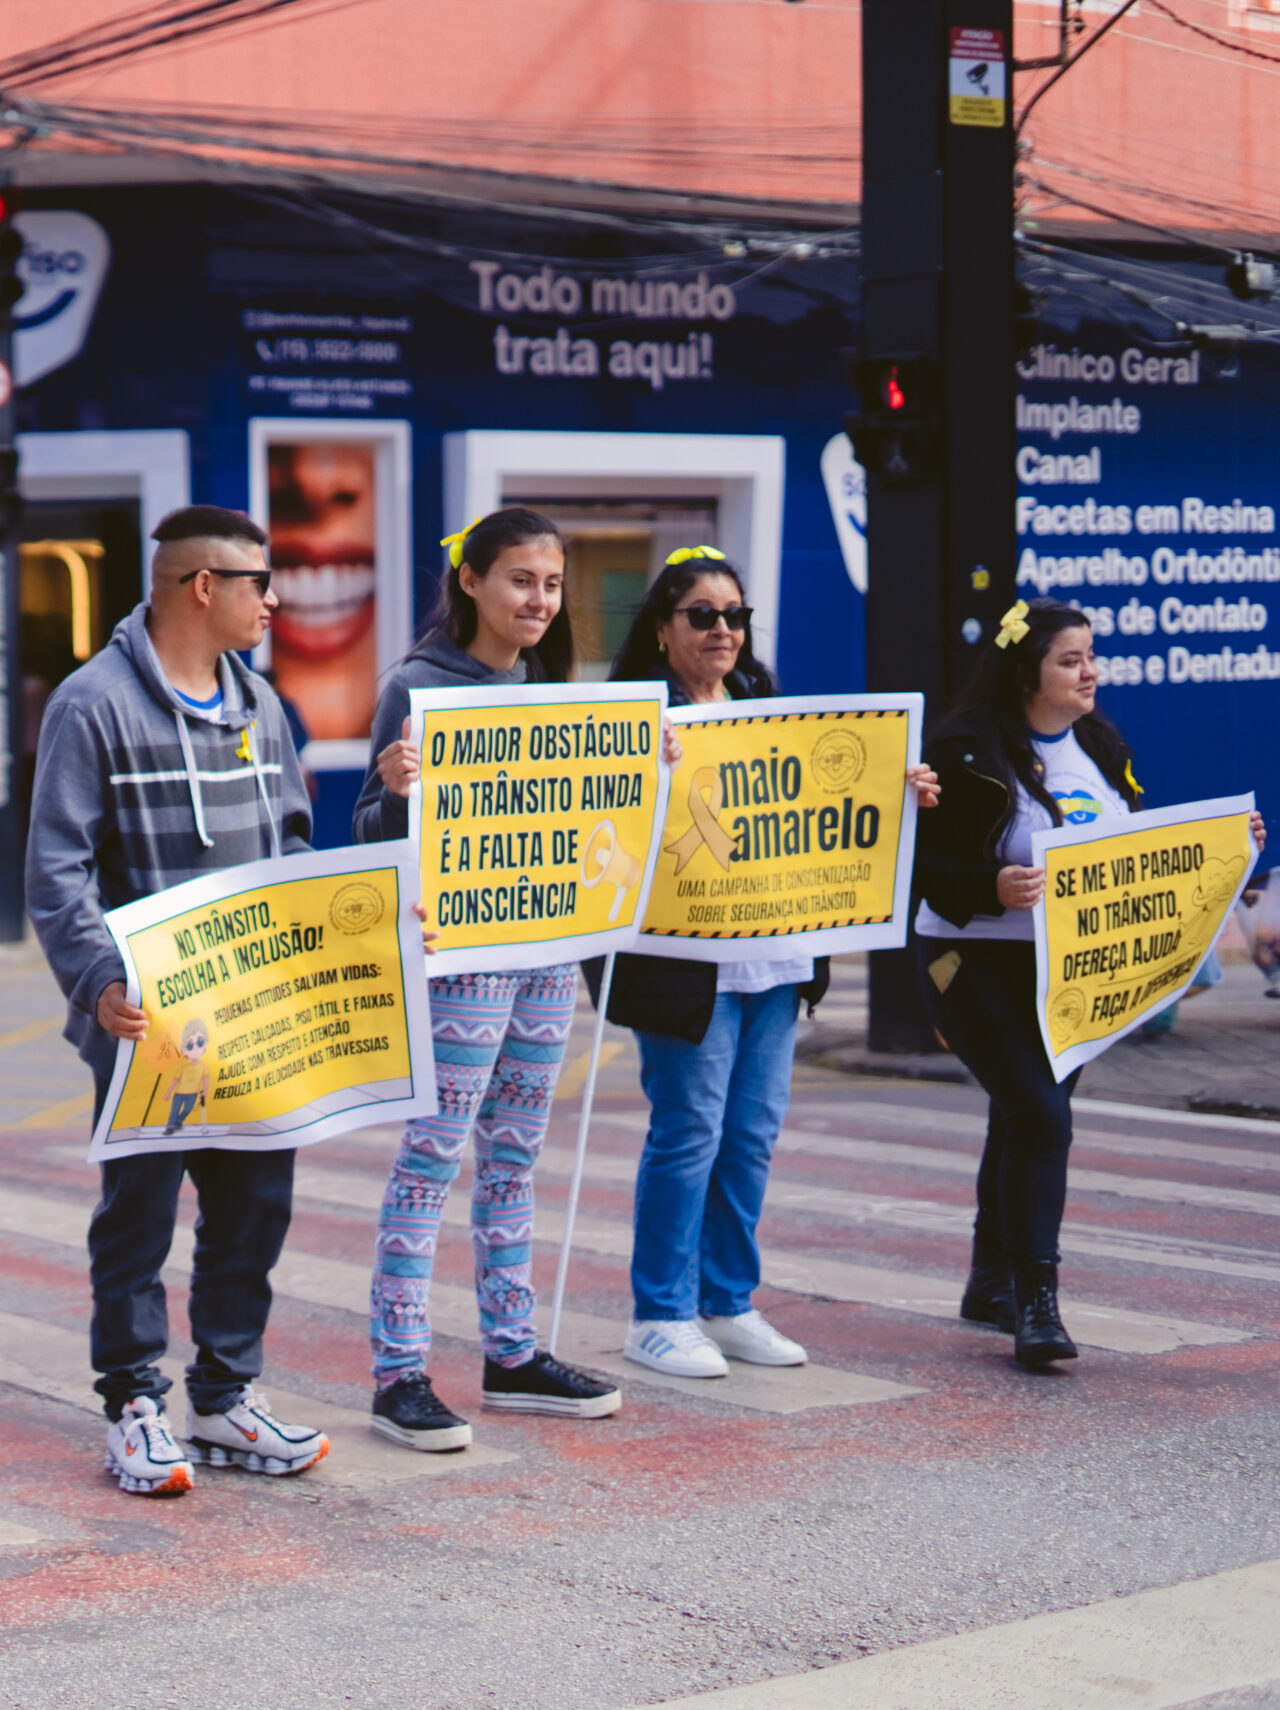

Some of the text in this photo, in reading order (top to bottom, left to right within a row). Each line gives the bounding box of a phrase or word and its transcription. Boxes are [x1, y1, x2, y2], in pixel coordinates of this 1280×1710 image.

[469, 260, 735, 319] Todo mundo
[494, 324, 714, 391] trata aqui!
[1121, 347, 1200, 384] Geral
[1015, 393, 1141, 440] Implante
[1015, 446, 1101, 485] Canal
[1015, 497, 1275, 535] Facetas em Resina
[1015, 548, 1149, 595] Aparelho
[1118, 597, 1157, 635] de
[1159, 596, 1268, 635] Contato
[1144, 655, 1166, 685] e
[430, 713, 651, 767] O MAIOR OBSTÁCULO
[436, 770, 643, 821] NO TRÂNSITO AINDA
[719, 746, 802, 810] maio
[440, 828, 579, 874] É A FALTA DE
[729, 797, 880, 863] amarelo
[677, 860, 871, 898] UMA CAMPANHA DE CONSCIENTIZAÇÃO
[1055, 842, 1205, 899] SE ME VIR PARADO
[437, 875, 577, 927] CONSCIÊNCIA
[687, 890, 856, 924] SOBRE SEGURANÇA NO TRÂNSITO
[1077, 890, 1183, 938] NO TRÂNSITO,
[173, 901, 277, 961] NO TRÂNSITO,
[1063, 928, 1182, 982] OFEREÇA AJUDA
[157, 921, 324, 1009] ESCOLHA A INCLUSÃO!
[214, 963, 382, 1027] PEQUENAS ATITUDES SALVAM VIDAS:
[1090, 989, 1130, 1026] FAÇA
[217, 1038, 250, 1061] RESPEITE
[296, 1008, 313, 1029] PISO
[313, 997, 340, 1020] TÁTIL
[344, 998, 350, 1013] E
[353, 993, 395, 1011] FAIXAS
[217, 1017, 350, 1083] AJUDE COM RESPEITO E ATENÇÃO
[213, 1036, 390, 1101] REDUZA A VELOCIDADE NAS TRAVESSIAS
